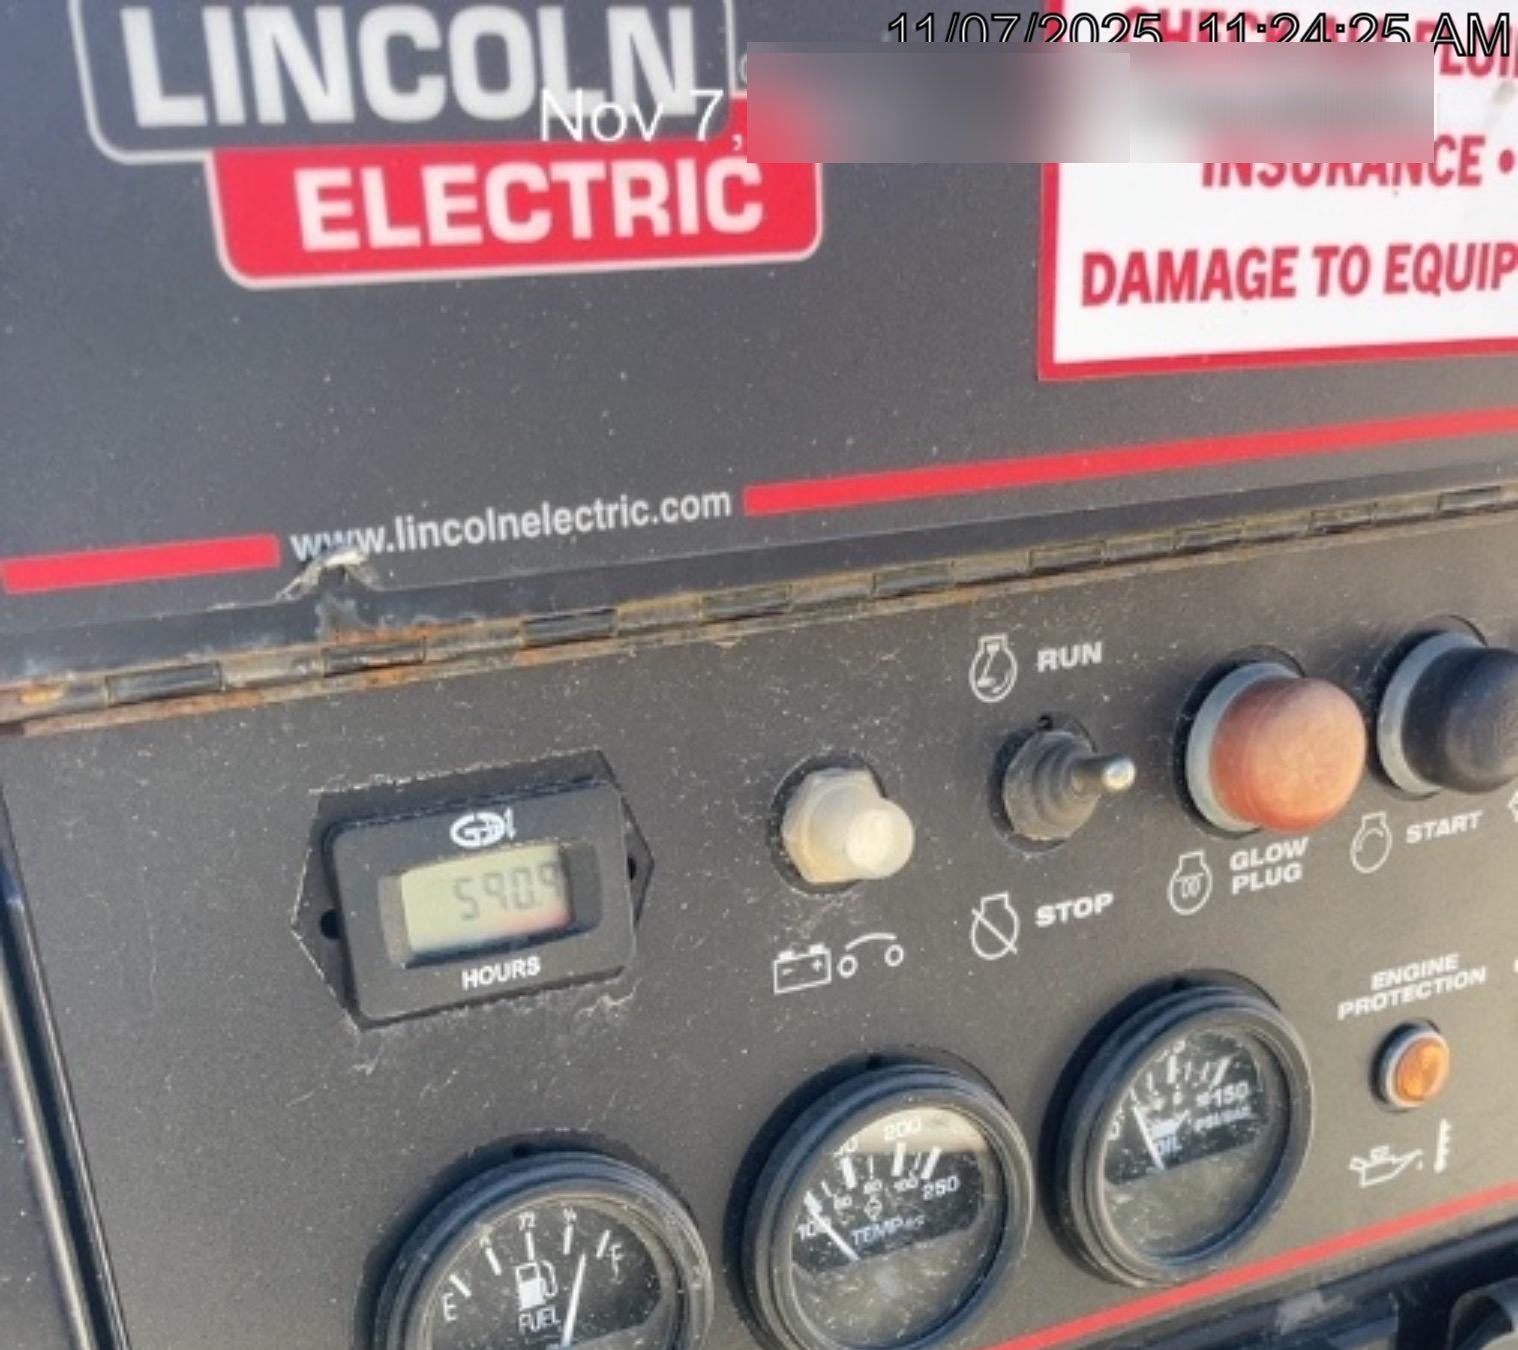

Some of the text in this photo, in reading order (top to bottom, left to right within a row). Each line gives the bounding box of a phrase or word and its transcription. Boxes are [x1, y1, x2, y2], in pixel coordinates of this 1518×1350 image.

[121, 4, 699, 128] LINCOLN
[293, 160, 764, 252] ELECTRIC
[1081, 245, 1299, 307] DAMAGE
[1312, 244, 1371, 297] TO
[290, 490, 732, 561] www.lincolnelectric.com
[1036, 642, 1102, 673] RUN
[1405, 809, 1484, 844] START
[1229, 837, 1309, 872] GLOW
[1231, 862, 1302, 896] PLUG
[1035, 892, 1114, 928] STOP
[461, 956, 541, 990] HOURS
[1370, 953, 1460, 991] ENGINE
[1337, 966, 1487, 1021] PROTECTION
[443, 1292, 458, 1322] E
[518, 1306, 561, 1336] FUEL
